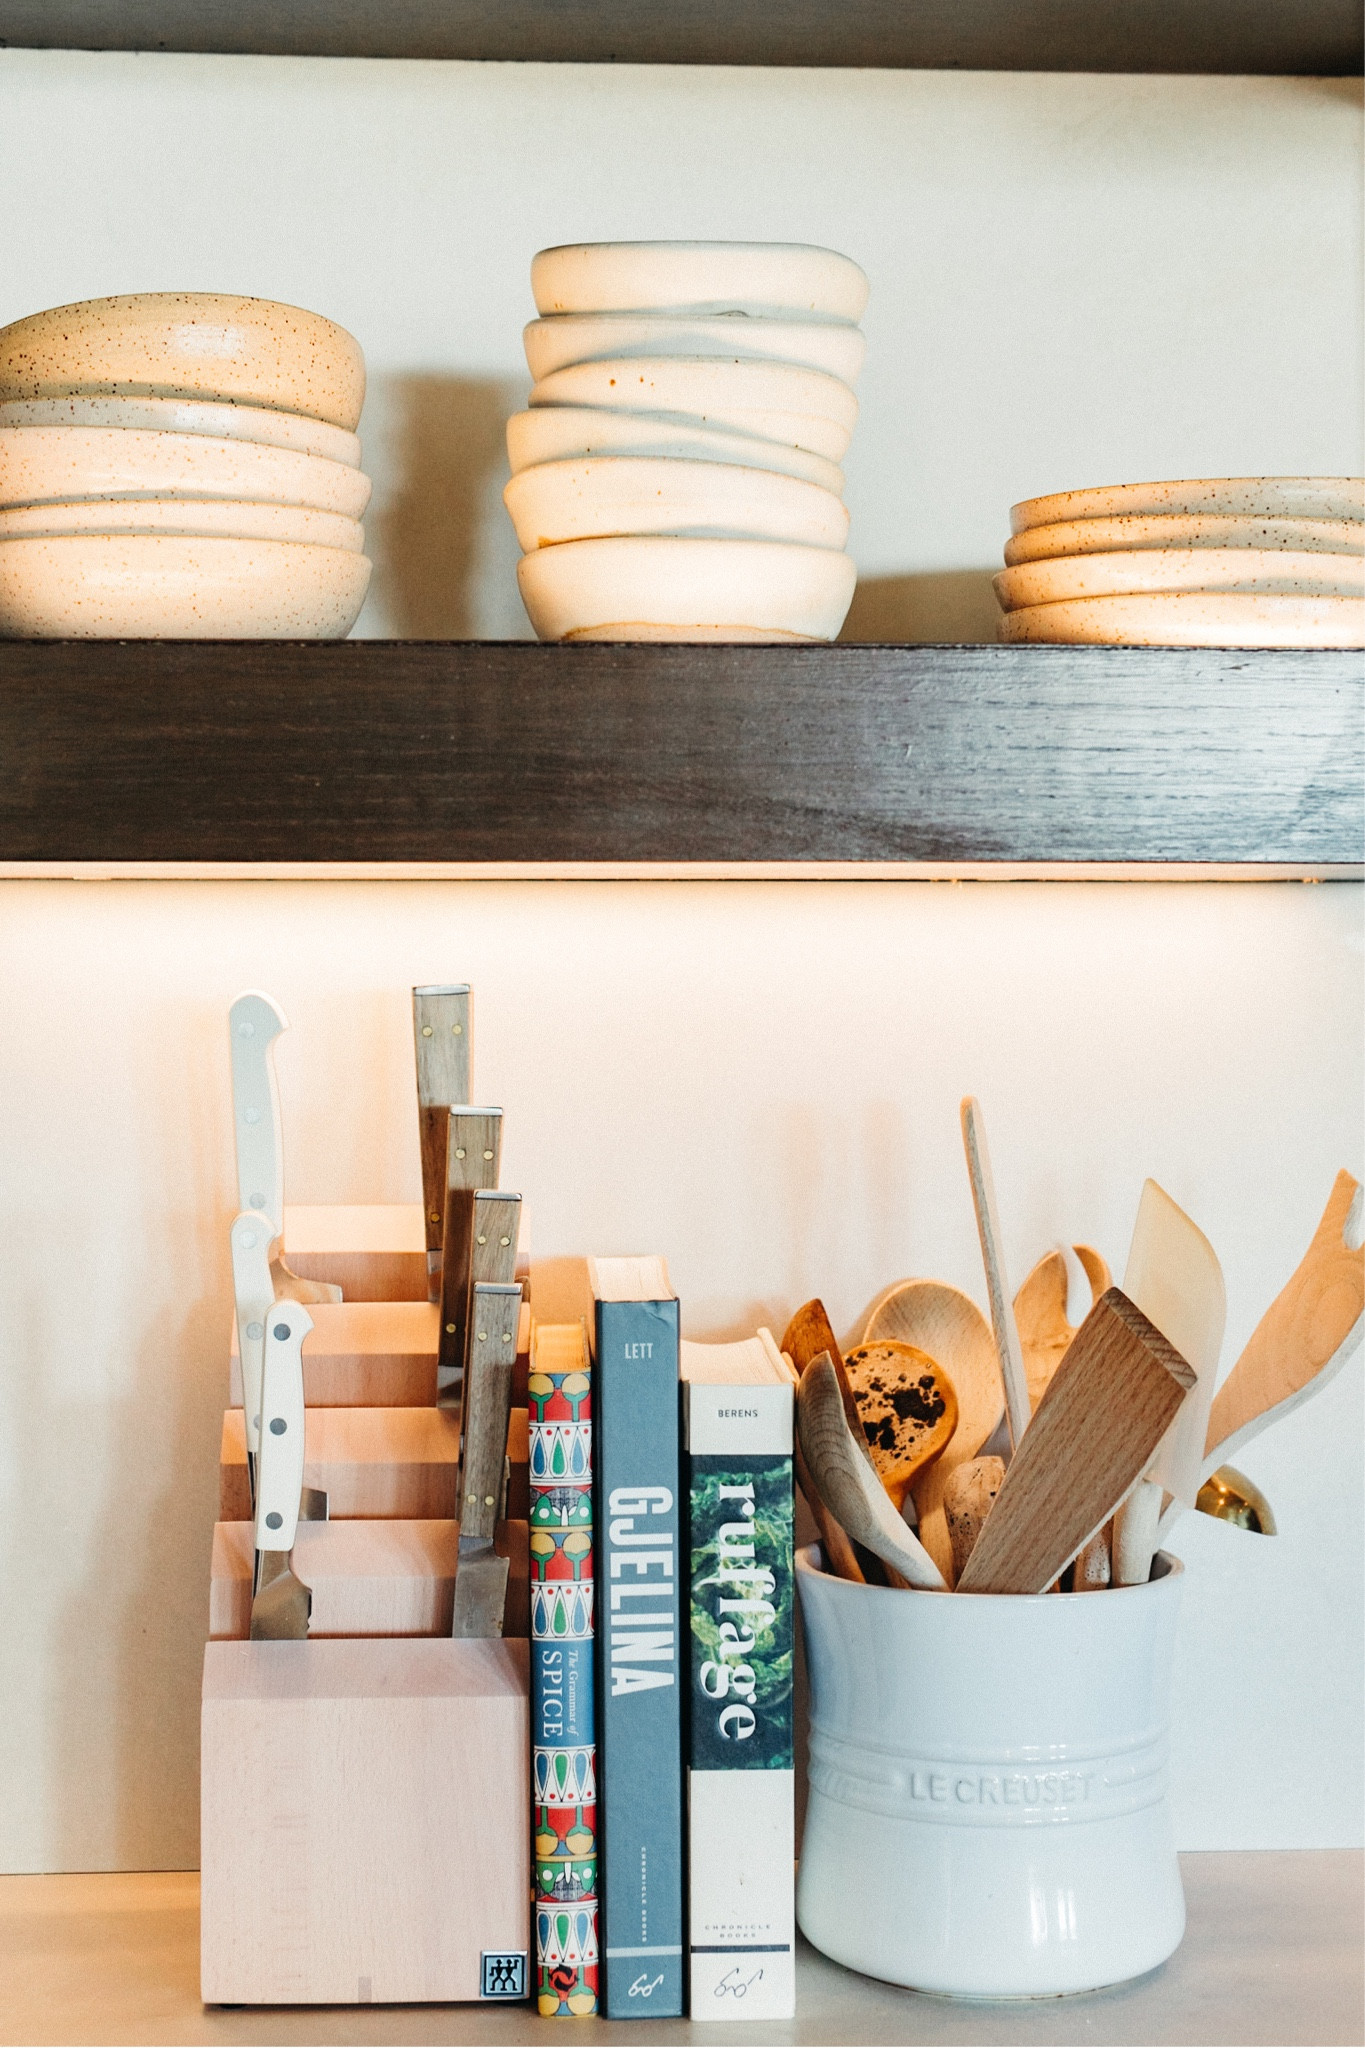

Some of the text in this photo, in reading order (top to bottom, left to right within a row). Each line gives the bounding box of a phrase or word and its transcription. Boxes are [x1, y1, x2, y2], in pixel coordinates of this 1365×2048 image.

[624, 1343, 654, 1360] LETT
[718, 1409, 758, 1419] BERENS
[608, 1486, 675, 1697] GJELINA
[691, 1482, 776, 1739] ruffage
[542, 1650, 563, 1738] SPICE
[566, 1649, 580, 1737] The Grammar of
[911, 1773, 1094, 1804] LE CREUSET
